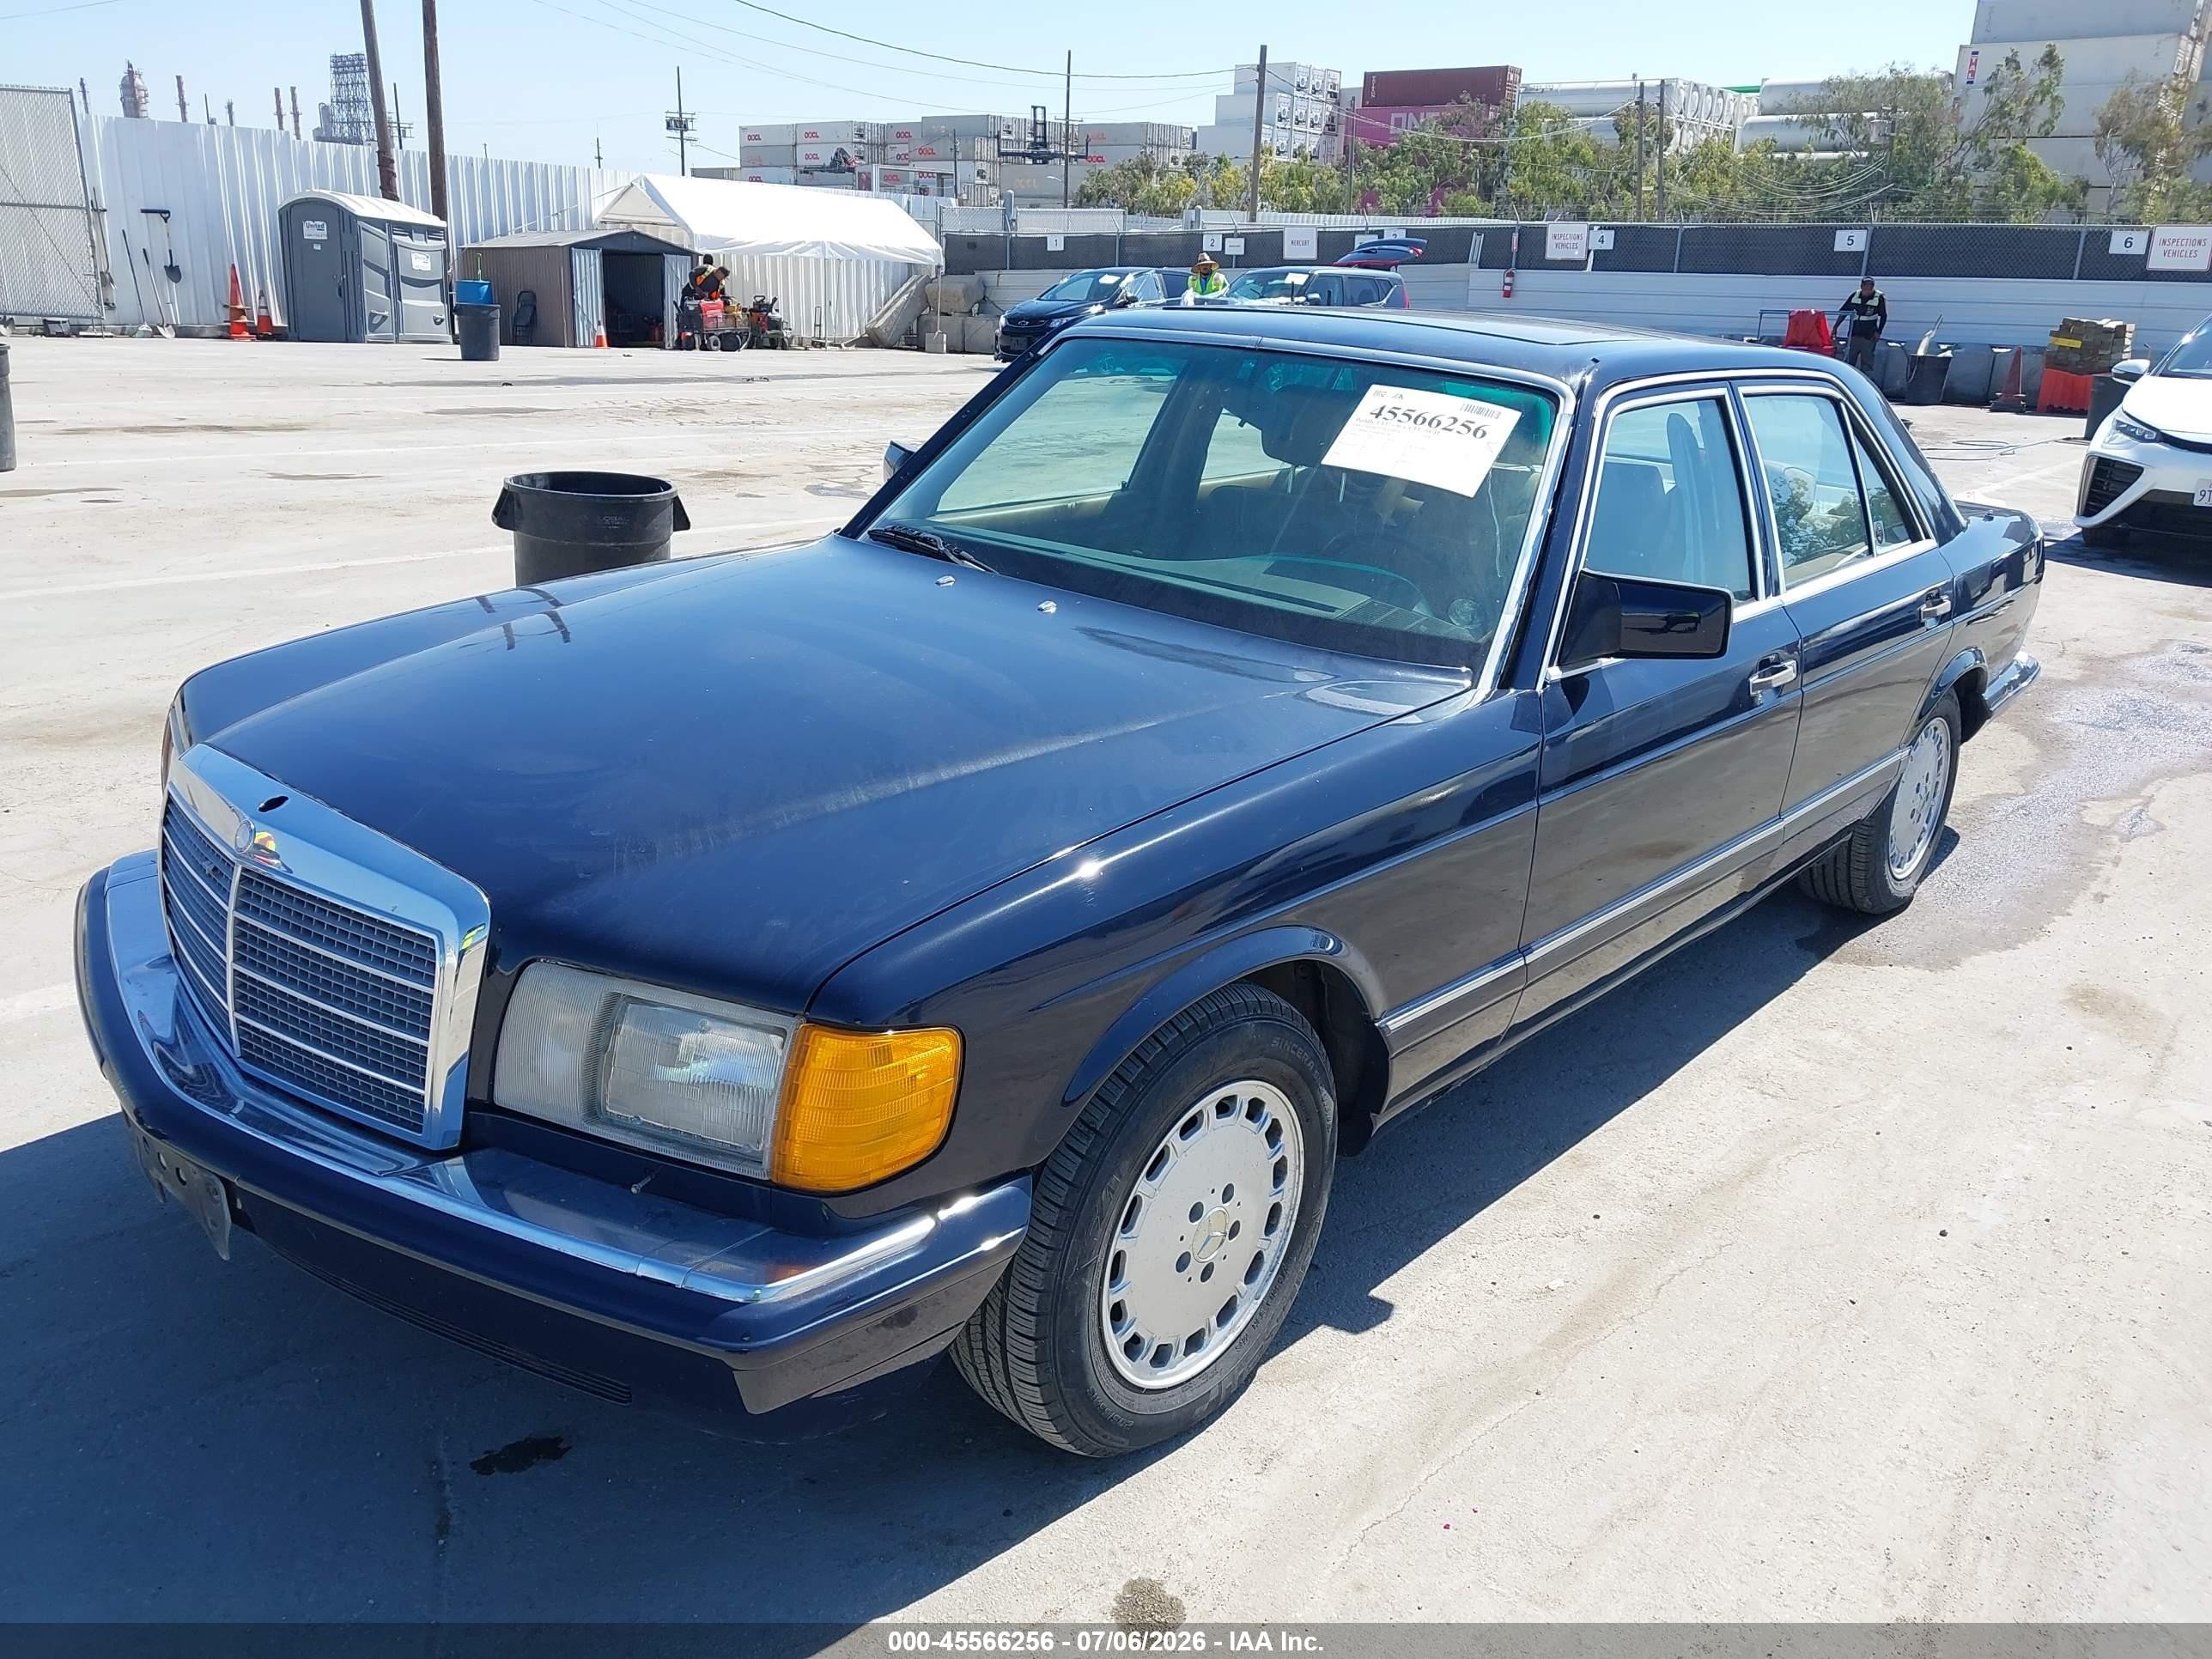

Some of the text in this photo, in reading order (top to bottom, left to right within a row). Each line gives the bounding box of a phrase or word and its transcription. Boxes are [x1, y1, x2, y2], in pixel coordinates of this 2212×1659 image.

[1209, 238, 1215, 247] 2
[1597, 234, 1605, 245] 4
[1846, 234, 1855, 246] 5
[2124, 236, 2134, 249] 6
[2158, 238, 2208, 247] INSPECTIONS
[2163, 249, 2198, 258] VEHICLES
[1369, 404, 1492, 440] 45566256
